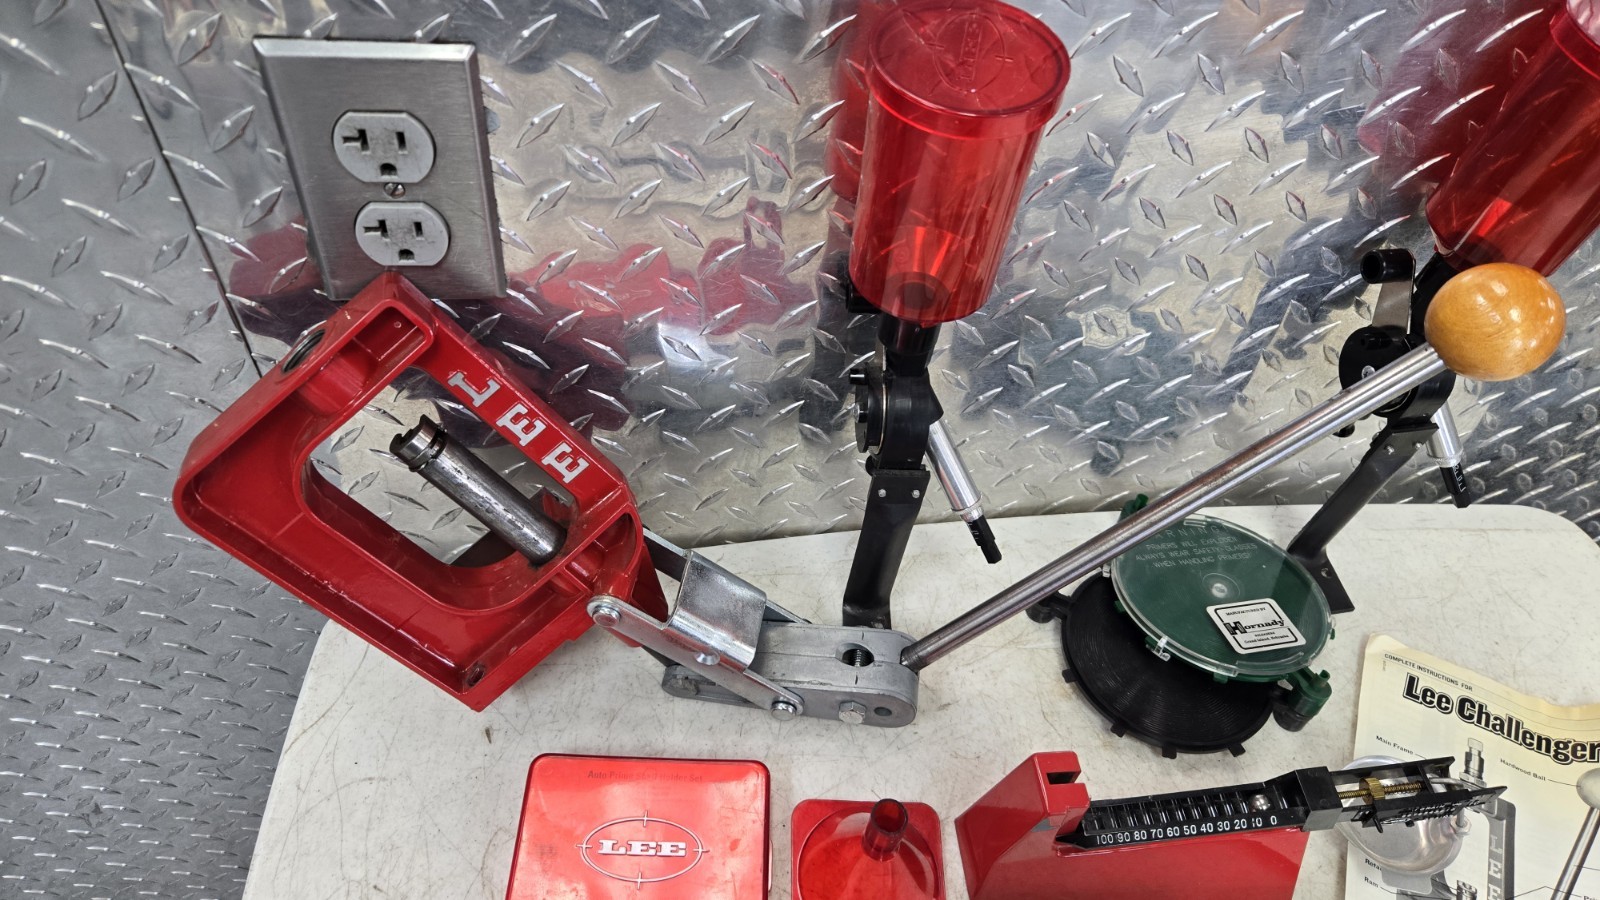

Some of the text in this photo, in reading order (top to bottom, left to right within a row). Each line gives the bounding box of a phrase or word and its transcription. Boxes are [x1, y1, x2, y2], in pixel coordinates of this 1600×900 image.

[447, 371, 591, 484] LEE
[1135, 551, 1166, 560] ALWAYS
[1168, 549, 1191, 558] WEAR
[1192, 546, 1222, 555] SAFETY
[1145, 542, 1178, 550] PRIMERS
[1152, 560, 1176, 568] WHEN
[1178, 556, 1215, 565] HANDLING
[1223, 619, 1285, 636] Hornady
[1384, 653, 1416, 669] COMPLETE
[1416, 665, 1459, 686] INSTRUCTIONS
[1461, 682, 1473, 692] FOR
[1402, 672, 1600, 766] Lee Challenger
[1376, 735, 1414, 755] Main Frame
[587, 770, 607, 779] Auto
[609, 771, 634, 780] Prime
[660, 772, 688, 781] Holder
[689, 774, 703, 782] Set
[1500, 758, 1532, 776] Hardwood
[1097, 815, 1278, 845] 100 90 80 70 60 50 40 30 20 10 0
[598, 839, 687, 857] LEE
[1488, 834, 1503, 900] LEE
[1364, 876, 1379, 888] Ram
